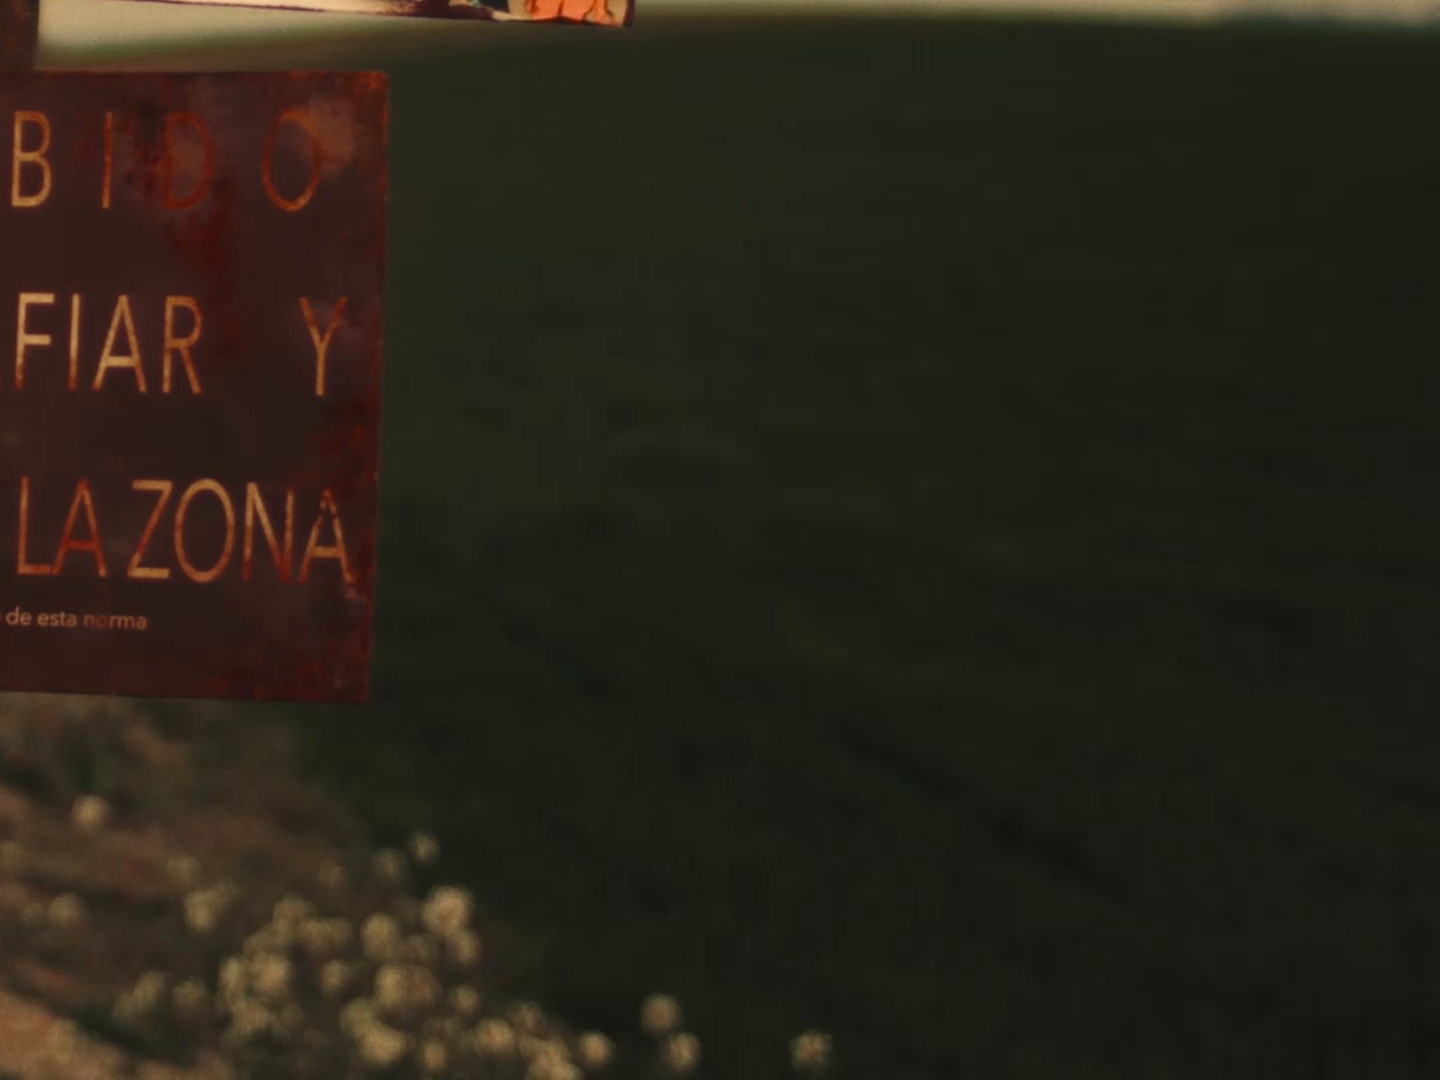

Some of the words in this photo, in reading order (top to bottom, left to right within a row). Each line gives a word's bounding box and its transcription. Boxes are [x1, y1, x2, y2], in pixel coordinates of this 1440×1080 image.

[297, 295, 348, 397] Y
[16, 475, 108, 578] LA
[126, 477, 356, 584] ZONA
[5, 606, 33, 626] de
[37, 609, 78, 628] esta
[83, 613, 148, 630] norma
